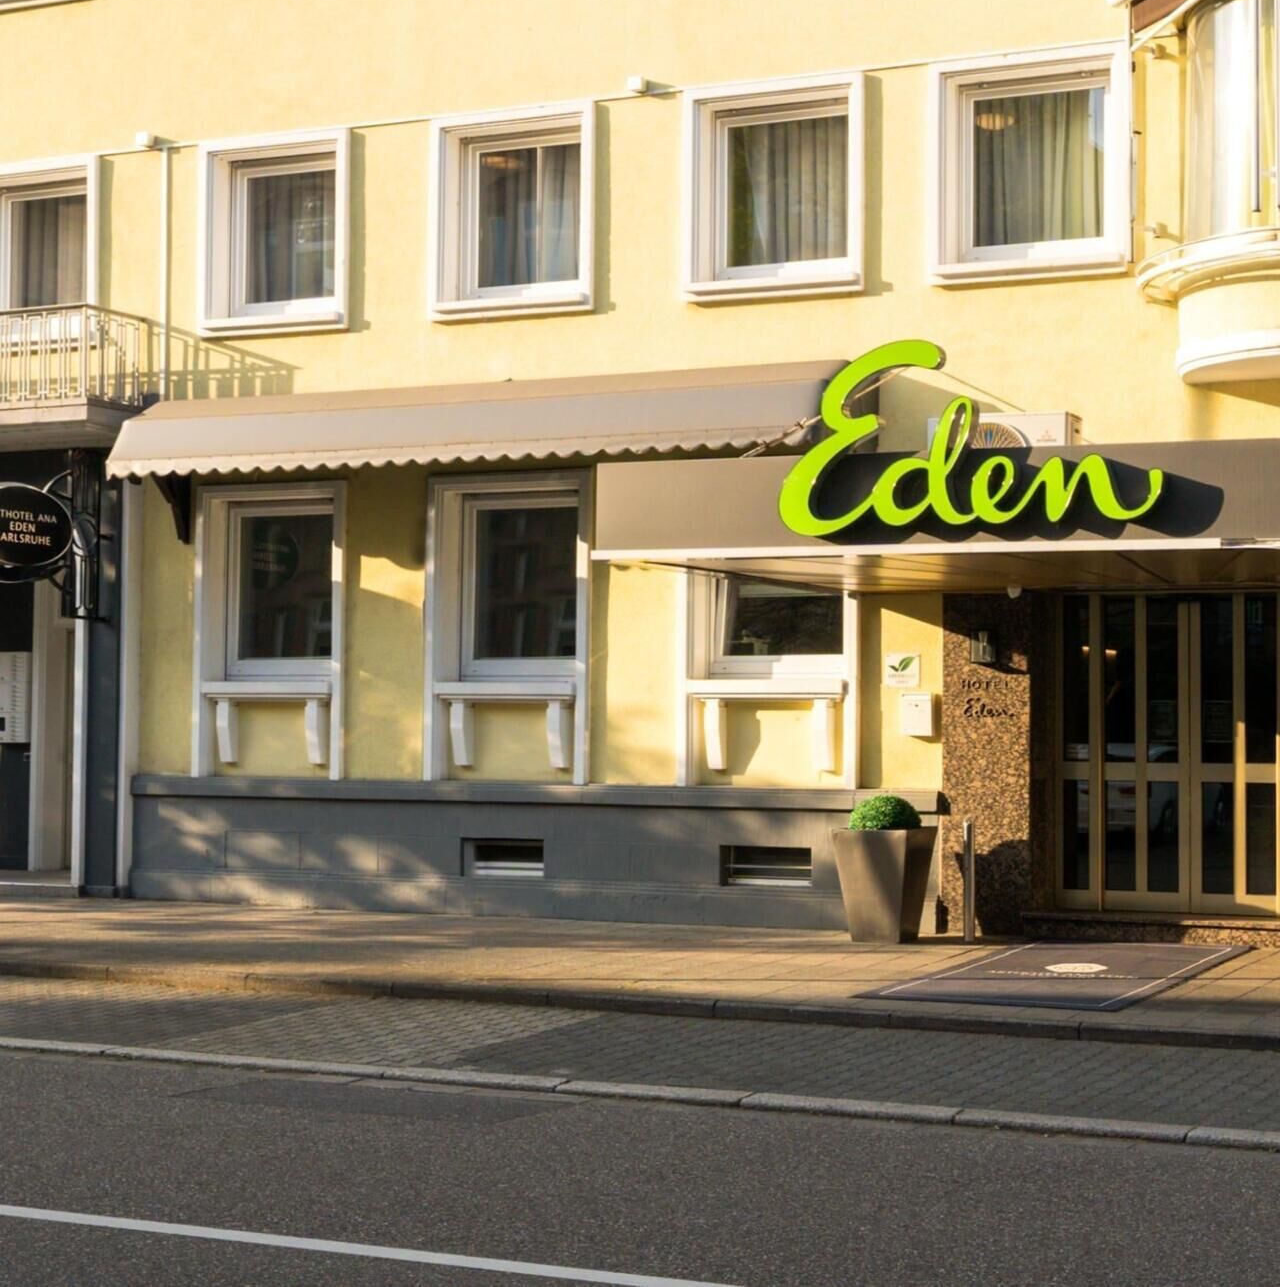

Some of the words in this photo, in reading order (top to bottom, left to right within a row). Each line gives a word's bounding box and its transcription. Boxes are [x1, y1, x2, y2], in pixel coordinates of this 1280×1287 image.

[778, 339, 1163, 537] Eden
[37, 514, 57, 523] ANA
[9, 521, 36, 533] EDEN
[961, 679, 1012, 690] HOTEL
